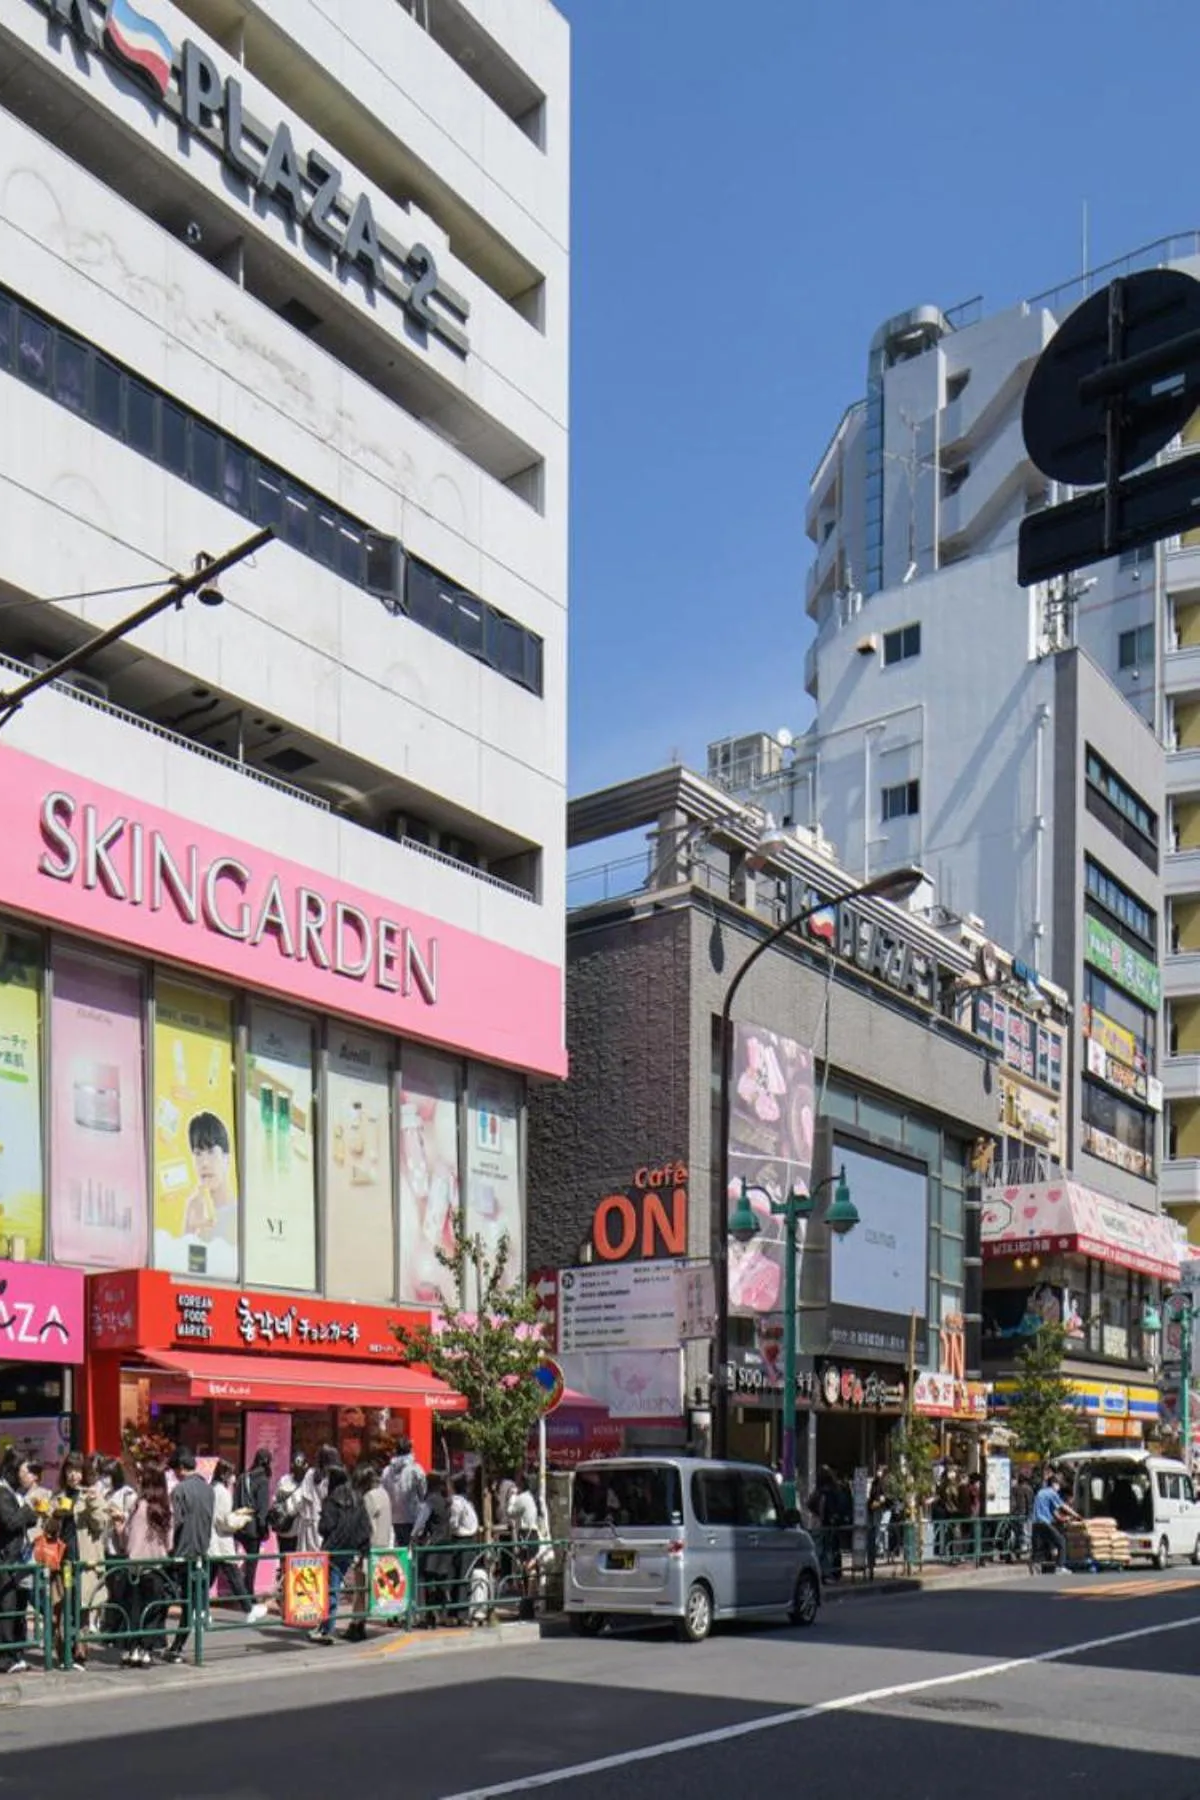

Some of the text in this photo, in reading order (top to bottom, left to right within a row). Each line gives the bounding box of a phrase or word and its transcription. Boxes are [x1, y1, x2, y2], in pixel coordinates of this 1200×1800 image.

[182, 36, 468, 359] PLAZA 2
[38, 790, 440, 1005] SKINGARDEN
[593, 1188, 687, 1260] ON
[177, 1294, 213, 1310] KOREAN
[183, 1308, 208, 1324] FOOD
[176, 1323, 213, 1339] MARKET
